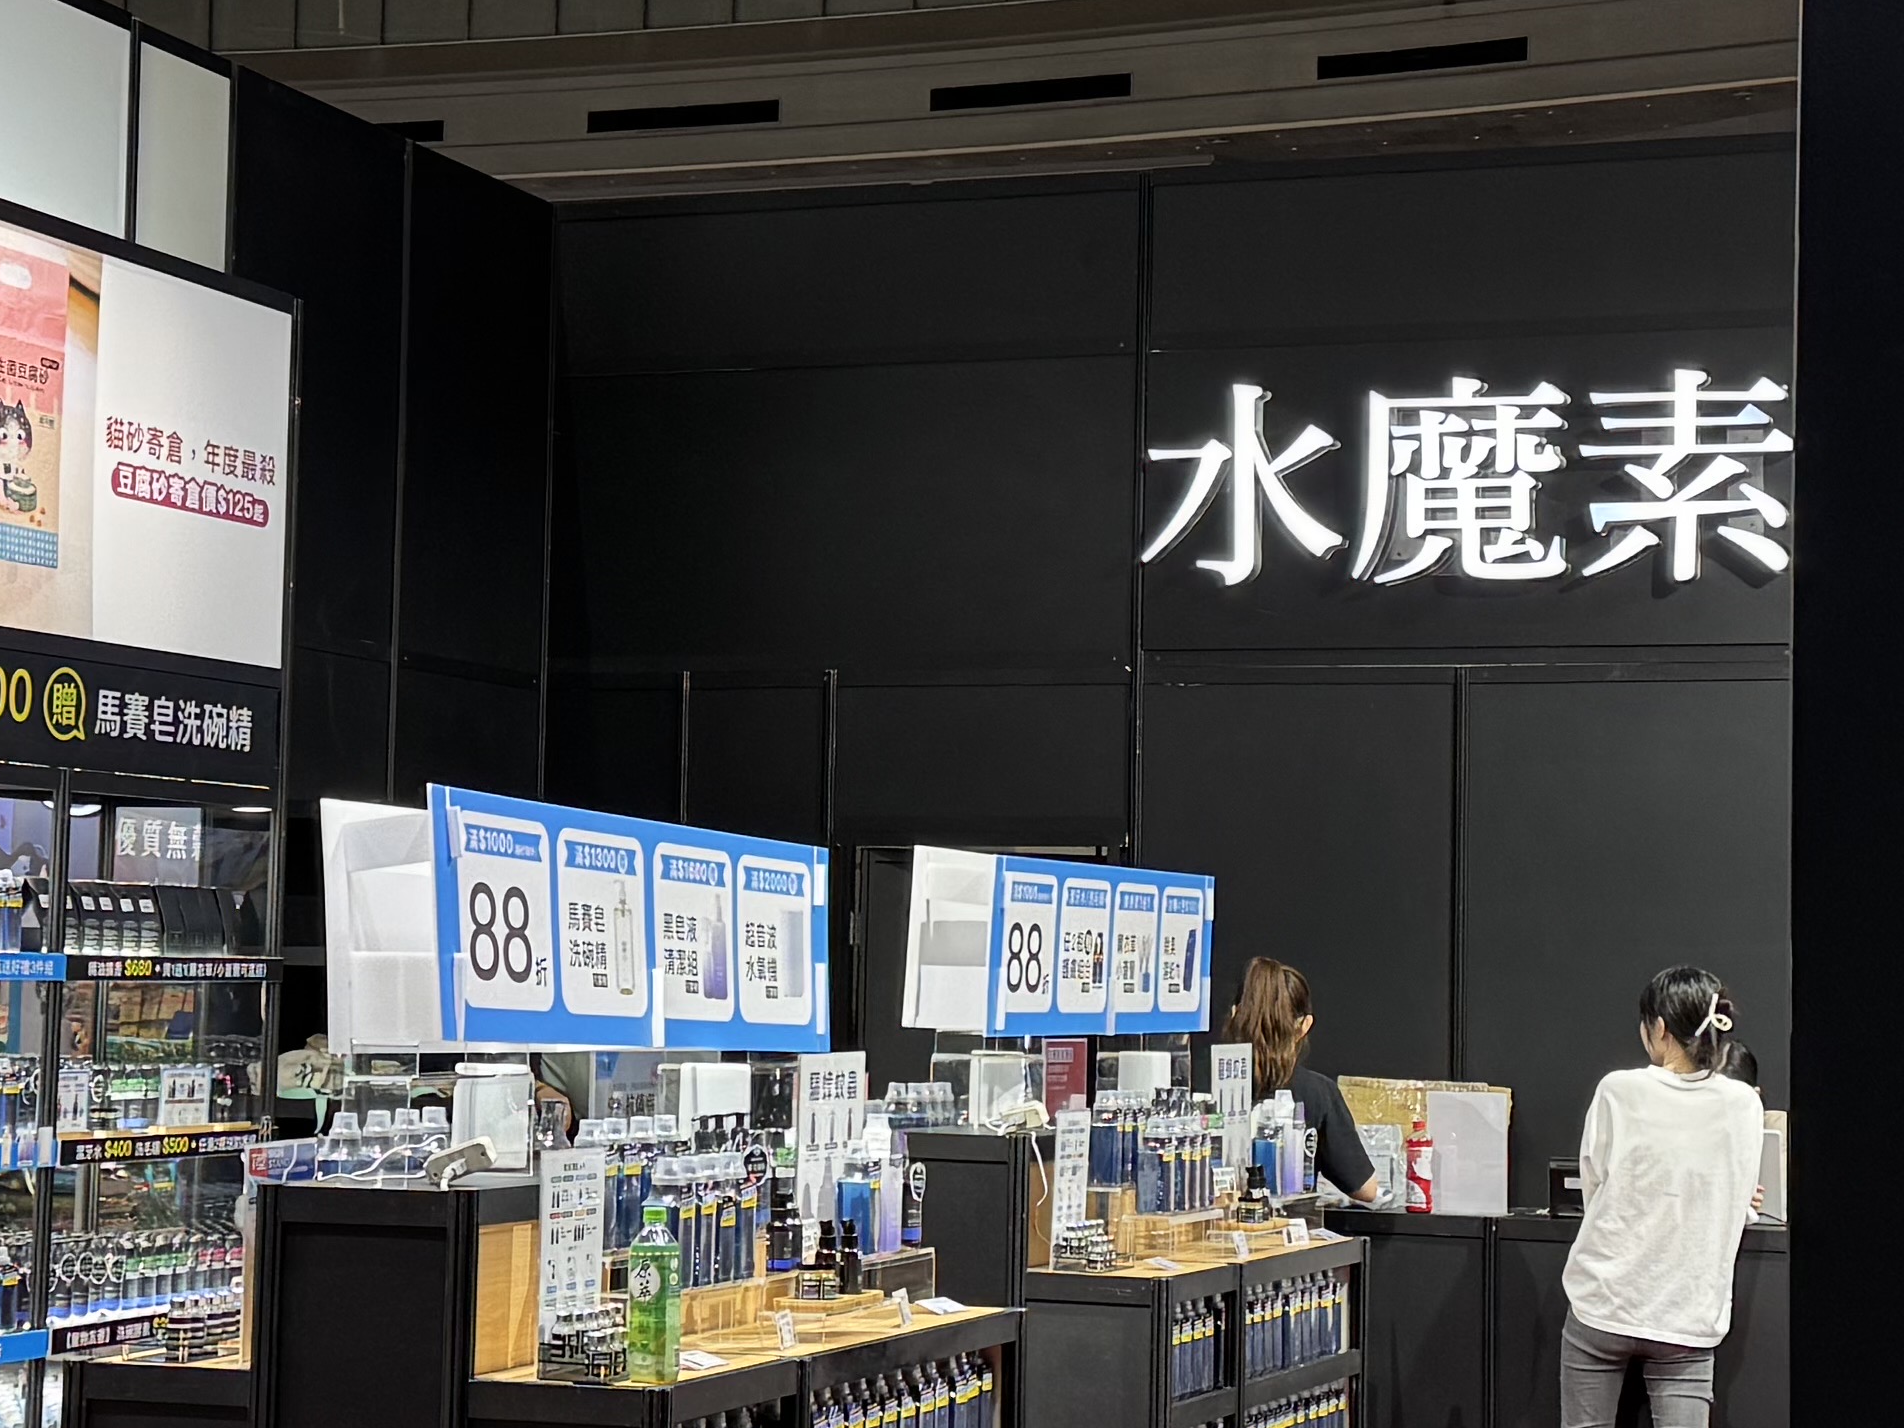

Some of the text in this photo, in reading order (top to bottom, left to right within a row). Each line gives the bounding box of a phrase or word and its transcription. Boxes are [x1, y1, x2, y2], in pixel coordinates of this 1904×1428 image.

[1140, 368, 1794, 585] 水魔素
[51, 681, 80, 728] 贈
[94, 689, 253, 753] 馬賽皂洗碗精
